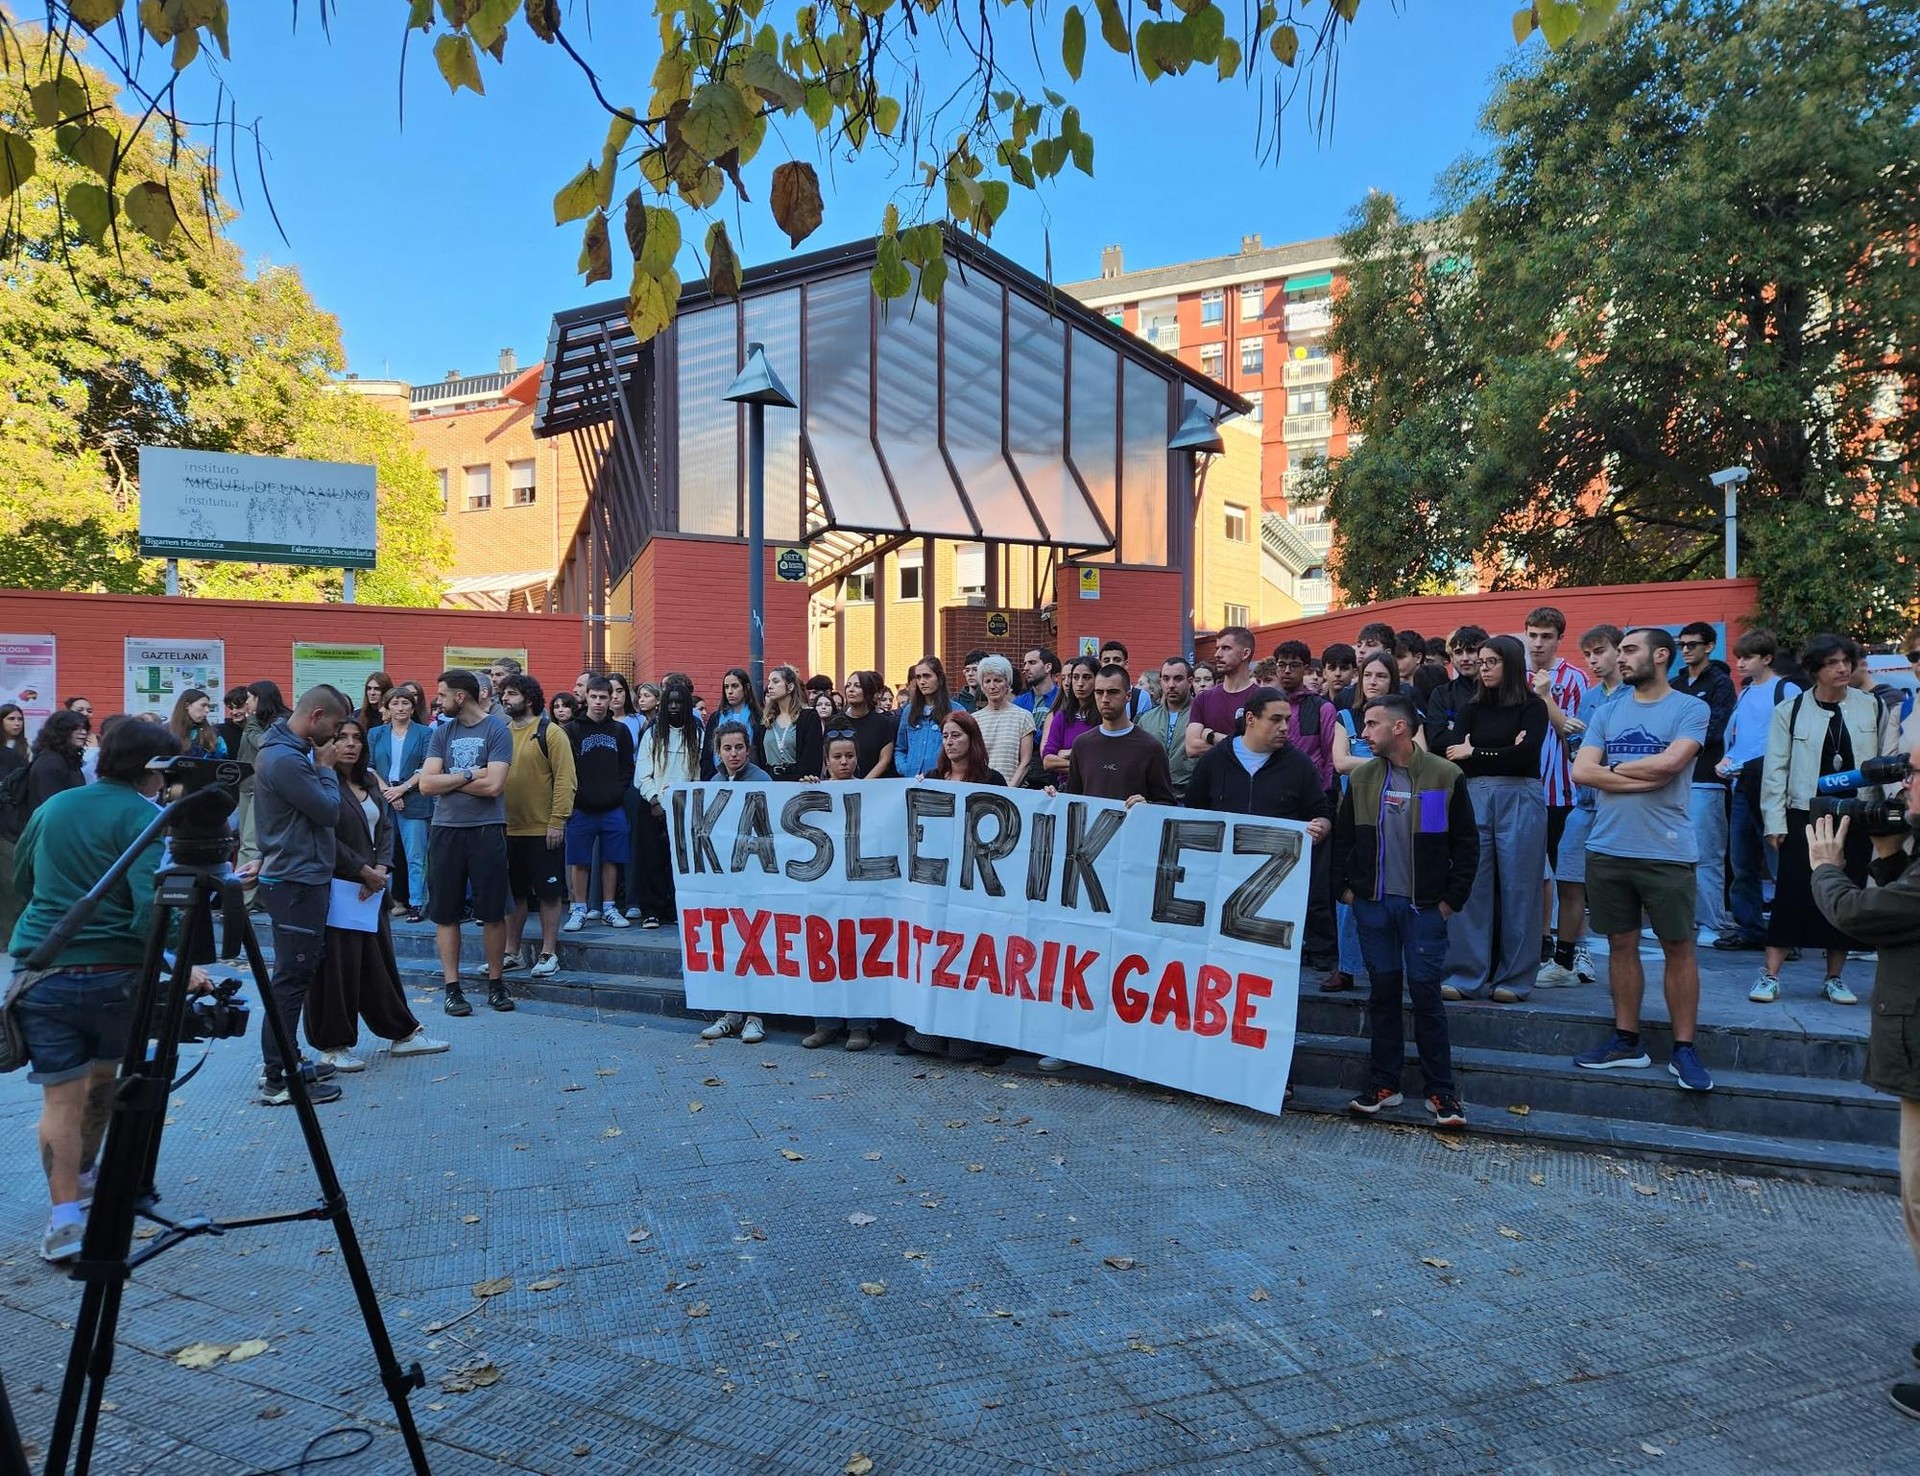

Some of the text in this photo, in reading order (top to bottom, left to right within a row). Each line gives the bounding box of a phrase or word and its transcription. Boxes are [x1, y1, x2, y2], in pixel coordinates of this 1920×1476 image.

[184, 461, 239, 475] instituto
[184, 494, 239, 508] institutua
[144, 537, 224, 549] Bigarren Hezkuntza
[291, 545, 373, 558] Educación Secundaria
[141, 651, 209, 660] GAZTELANIA
[1824, 774, 1850, 787] tve
[670, 787, 1304, 950] IKASLERIK EZ
[682, 906, 1274, 1050] ETXEBIZITZARIK GABE
